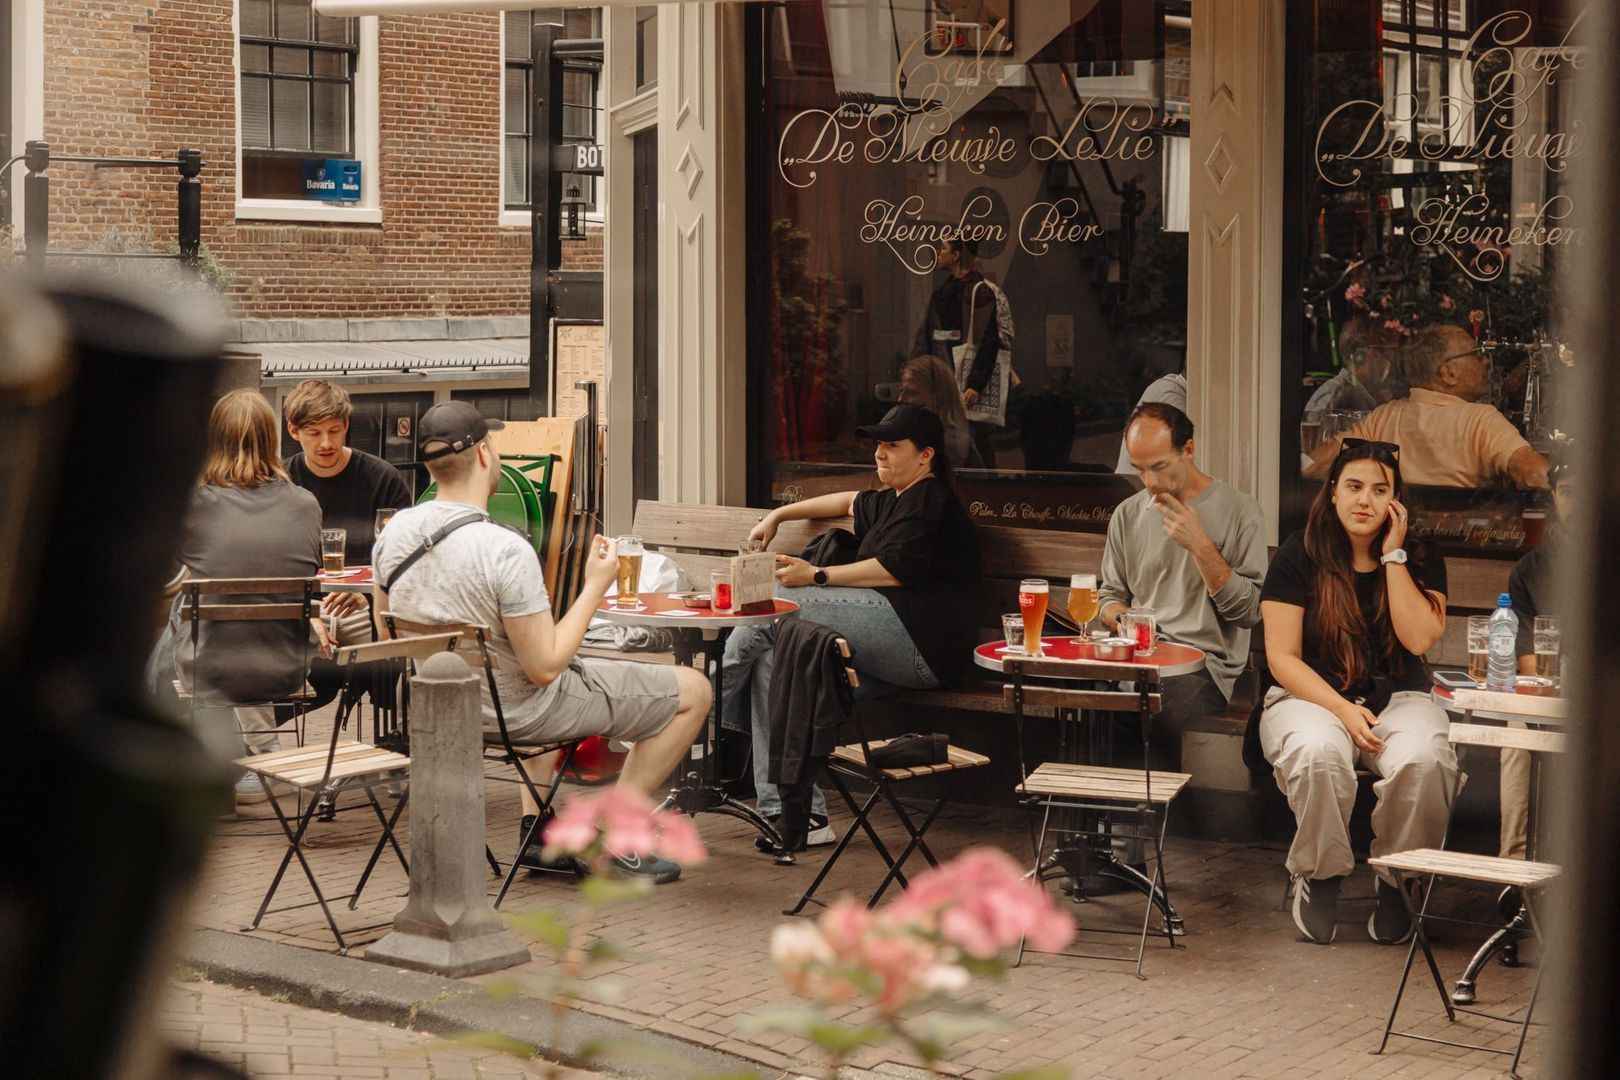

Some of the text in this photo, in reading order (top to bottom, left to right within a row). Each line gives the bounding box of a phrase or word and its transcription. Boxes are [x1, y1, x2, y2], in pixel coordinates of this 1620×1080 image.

[864, 105, 1017, 175] Nieuwe
[1419, 96, 1586, 172] Nieuw
[306, 180, 335, 190] Bavaria
[860, 195, 1104, 275] Heineken Bier
[1410, 194, 1584, 281] Heineken
